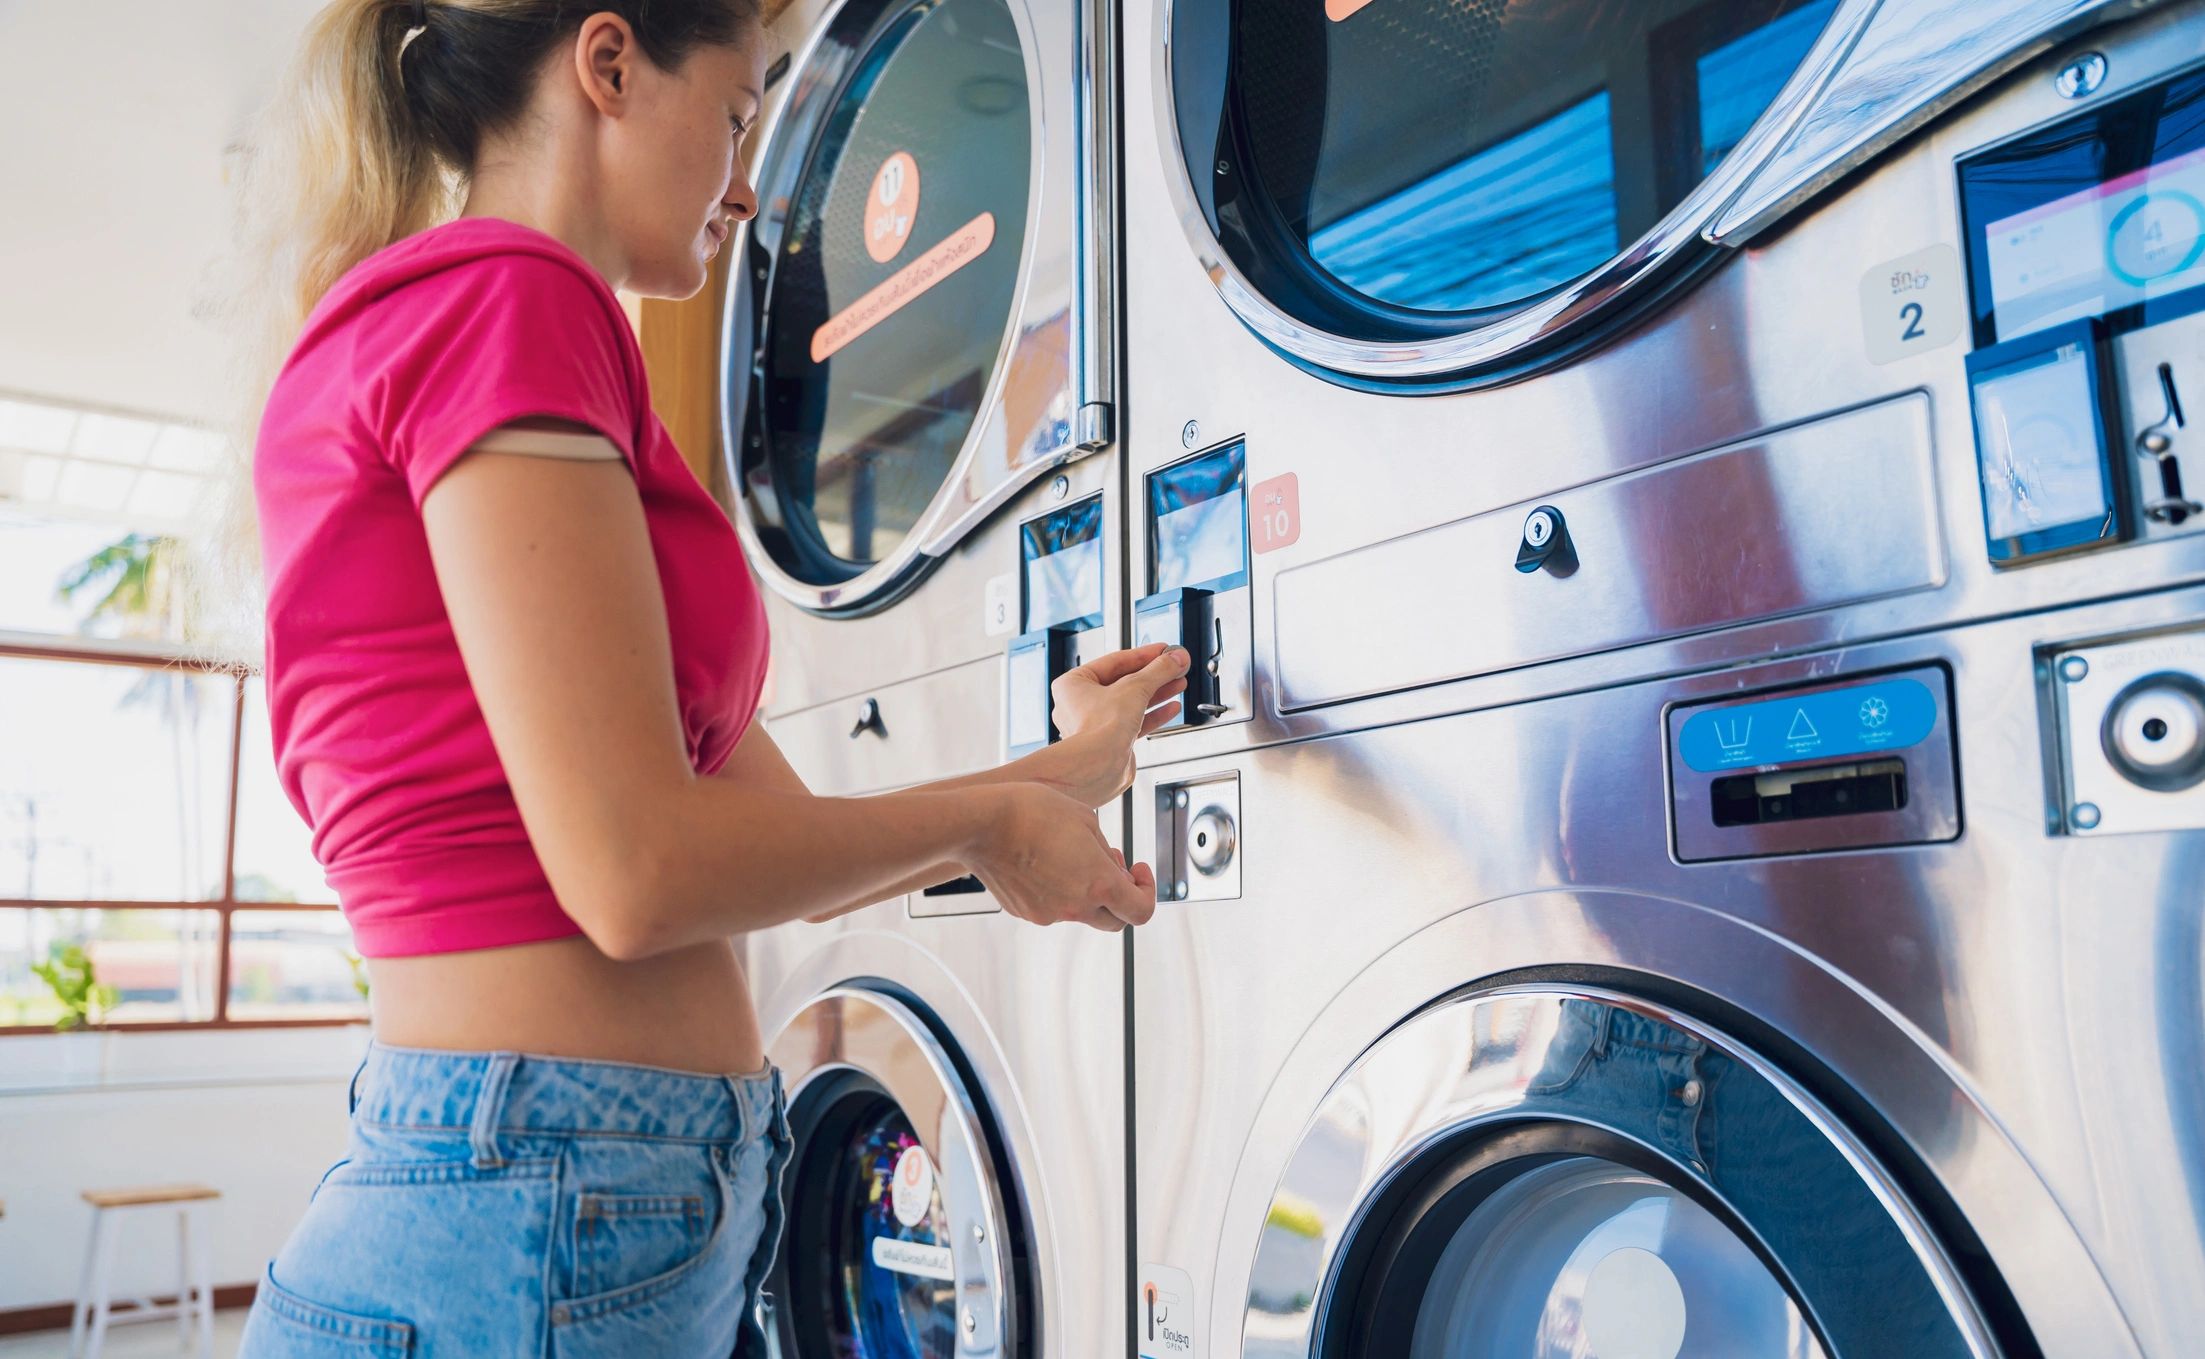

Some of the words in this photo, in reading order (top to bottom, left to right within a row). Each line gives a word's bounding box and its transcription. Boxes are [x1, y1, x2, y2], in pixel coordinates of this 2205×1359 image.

[1900, 302, 1925, 341] 2
[1263, 510, 1290, 542] 10
[997, 603, 1006, 625] 3
[1165, 1341, 1183, 1352] OPEN
